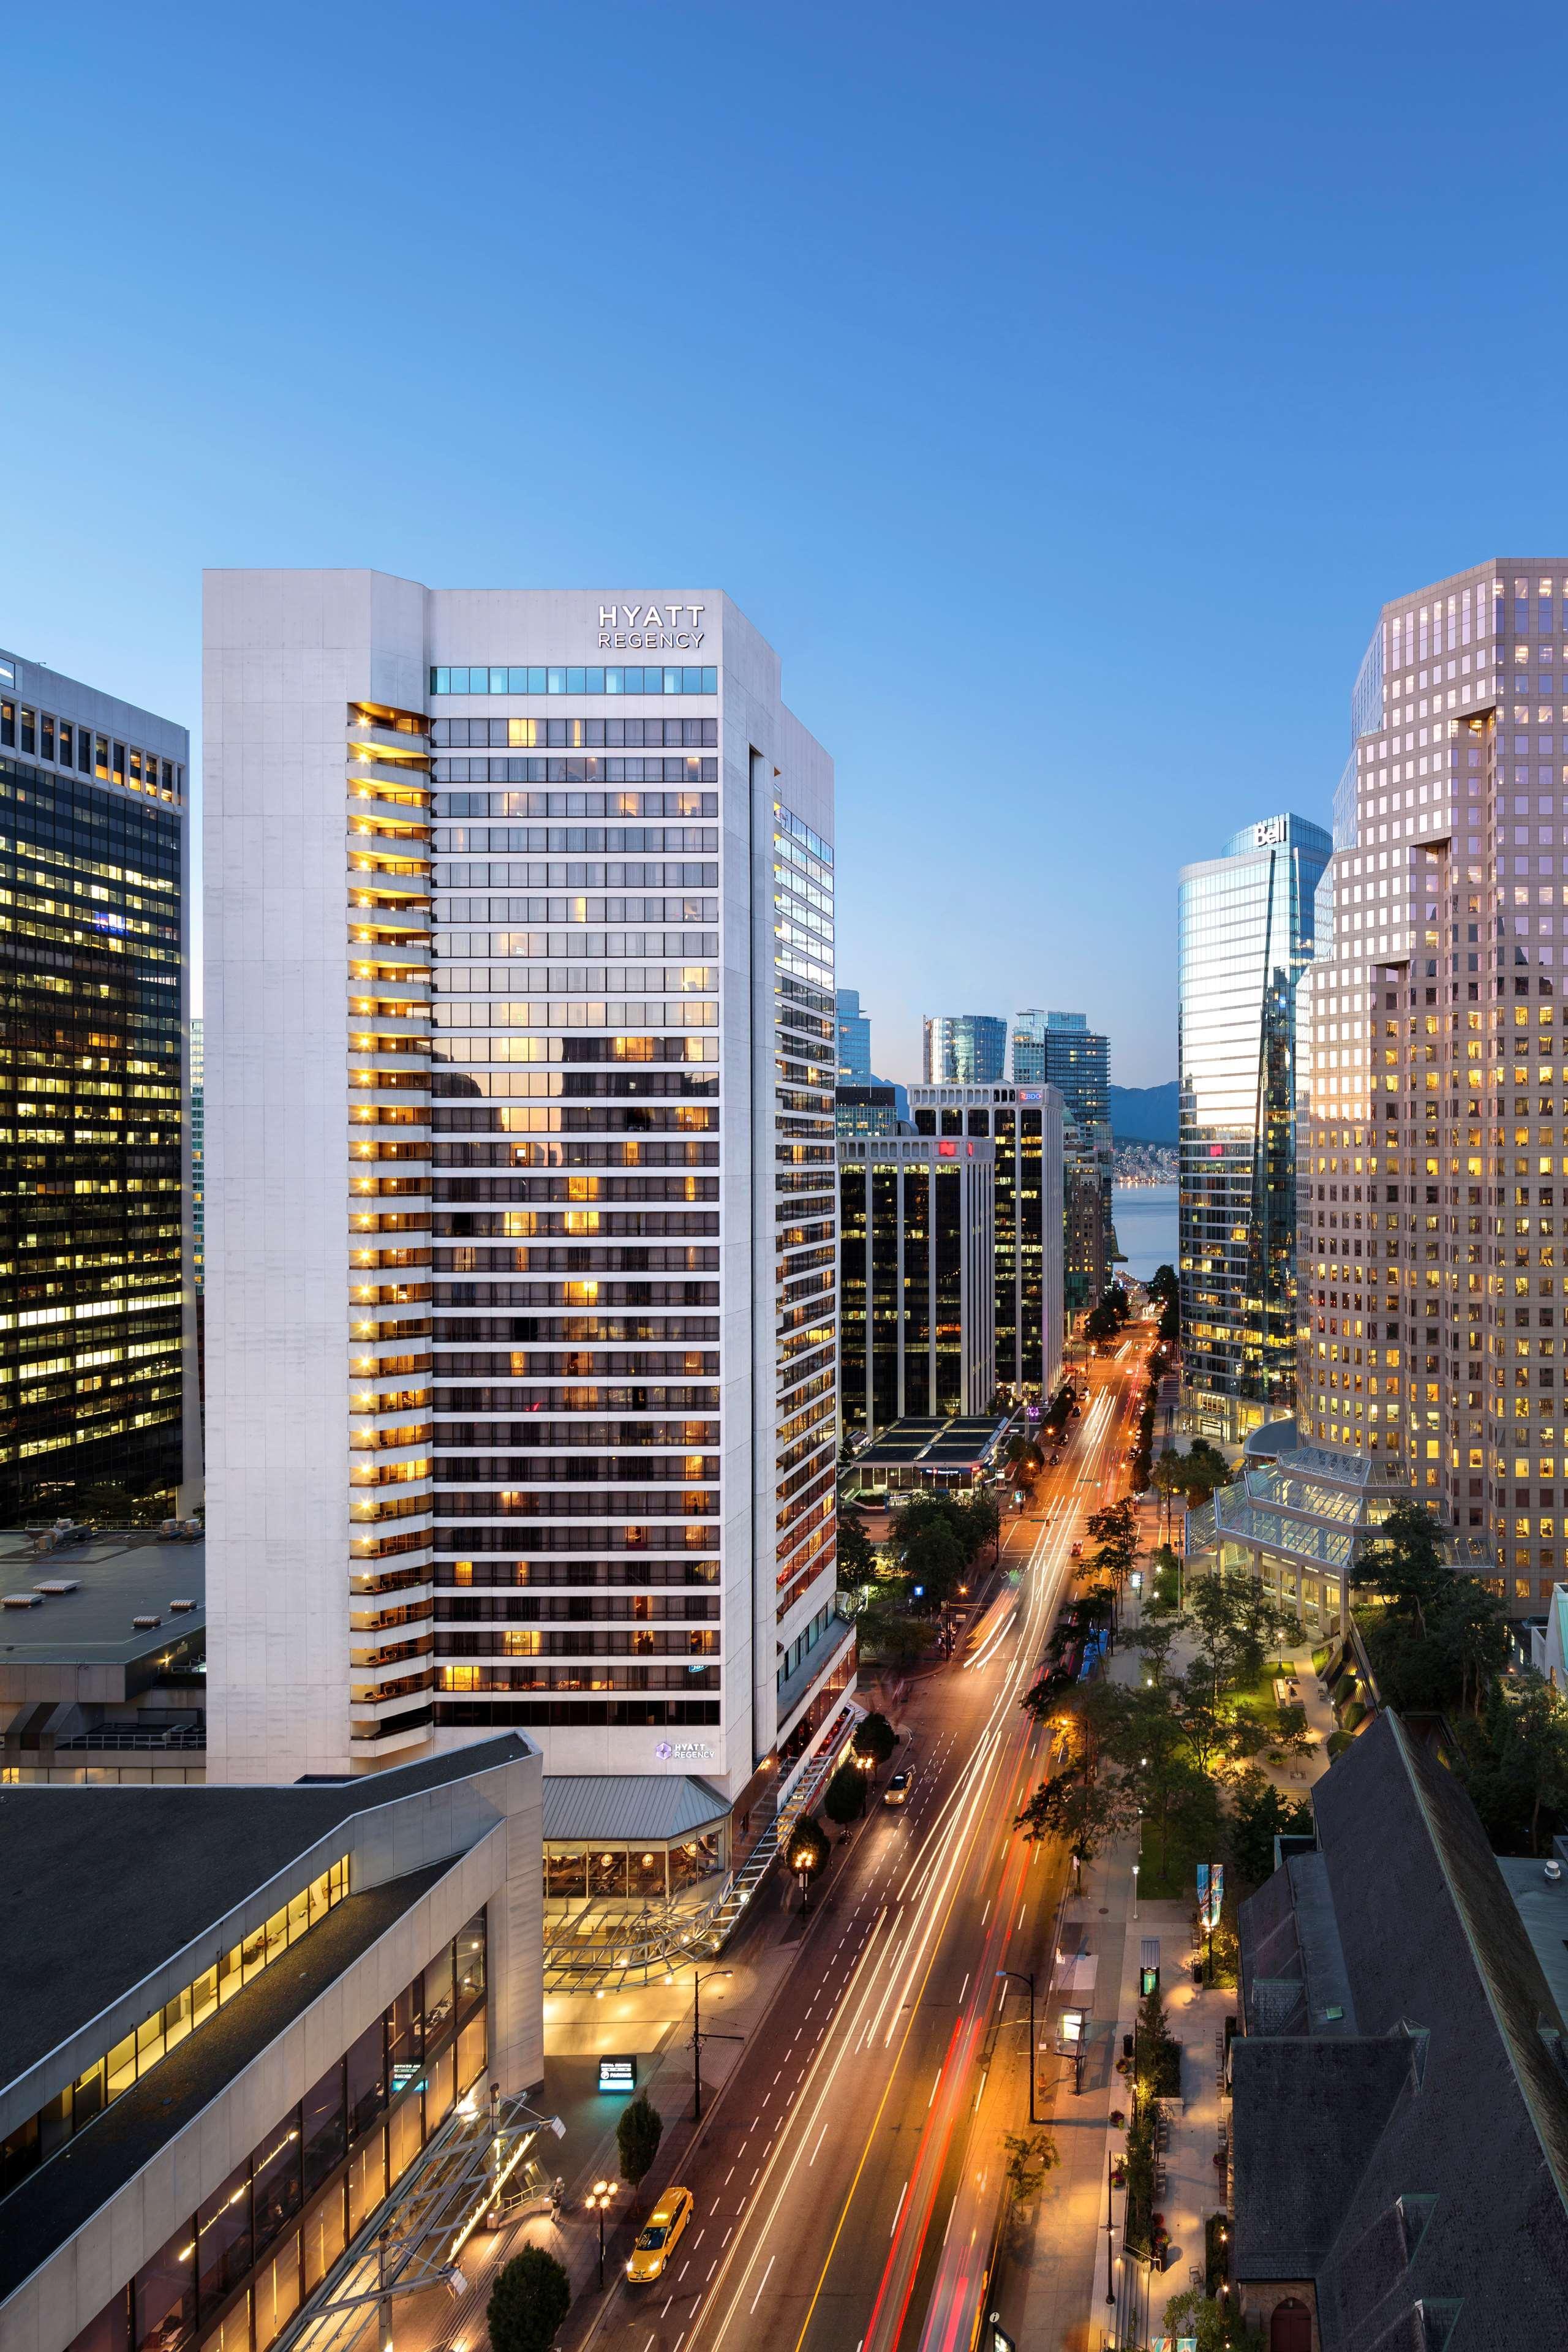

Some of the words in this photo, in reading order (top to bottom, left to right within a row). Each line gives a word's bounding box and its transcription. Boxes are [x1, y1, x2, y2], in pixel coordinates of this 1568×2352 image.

[599, 605, 704, 627] HYATT
[598, 632, 704, 648] REGENCY
[1254, 820, 1286, 846] Bell
